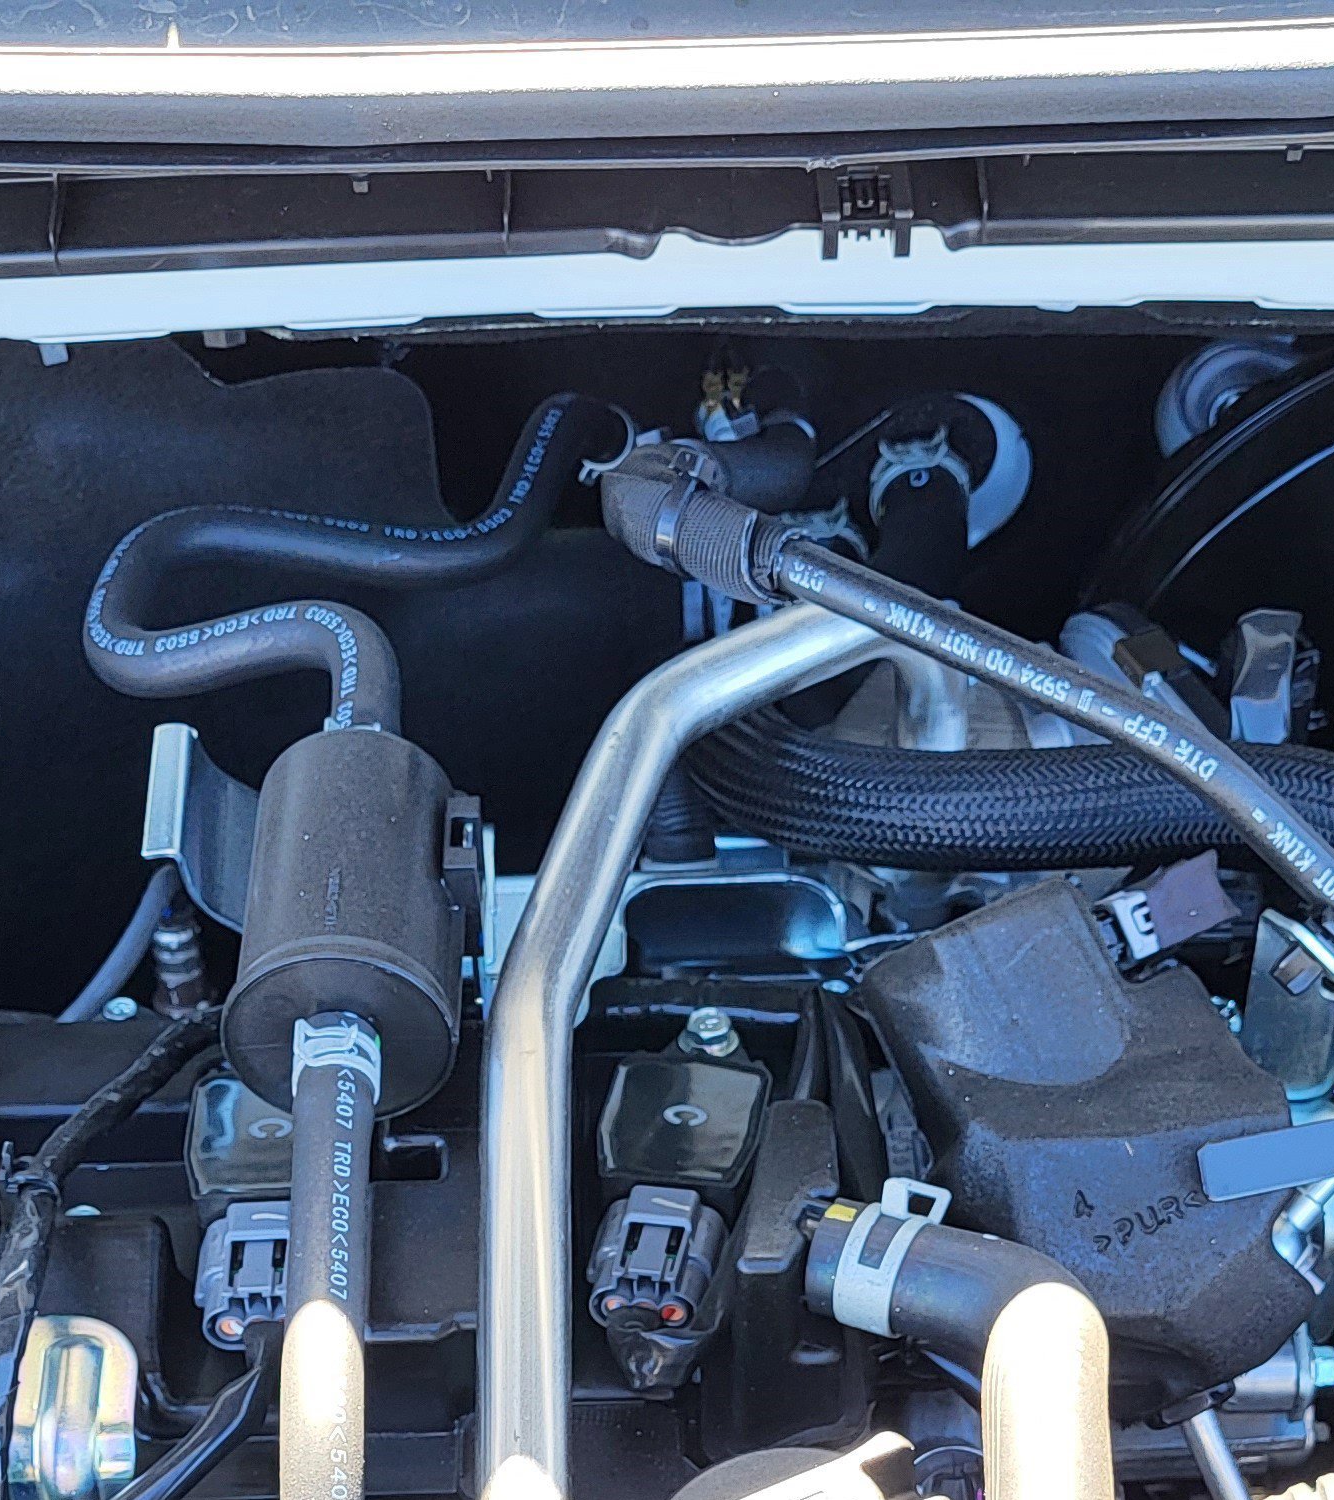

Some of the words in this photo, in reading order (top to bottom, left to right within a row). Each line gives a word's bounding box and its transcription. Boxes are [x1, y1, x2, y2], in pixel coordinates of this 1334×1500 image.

[885, 602, 936, 643] KINK
[940, 627, 982, 663] NOT
[1122, 714, 1169, 748] CFP
[1267, 820, 1319, 873] KINK
